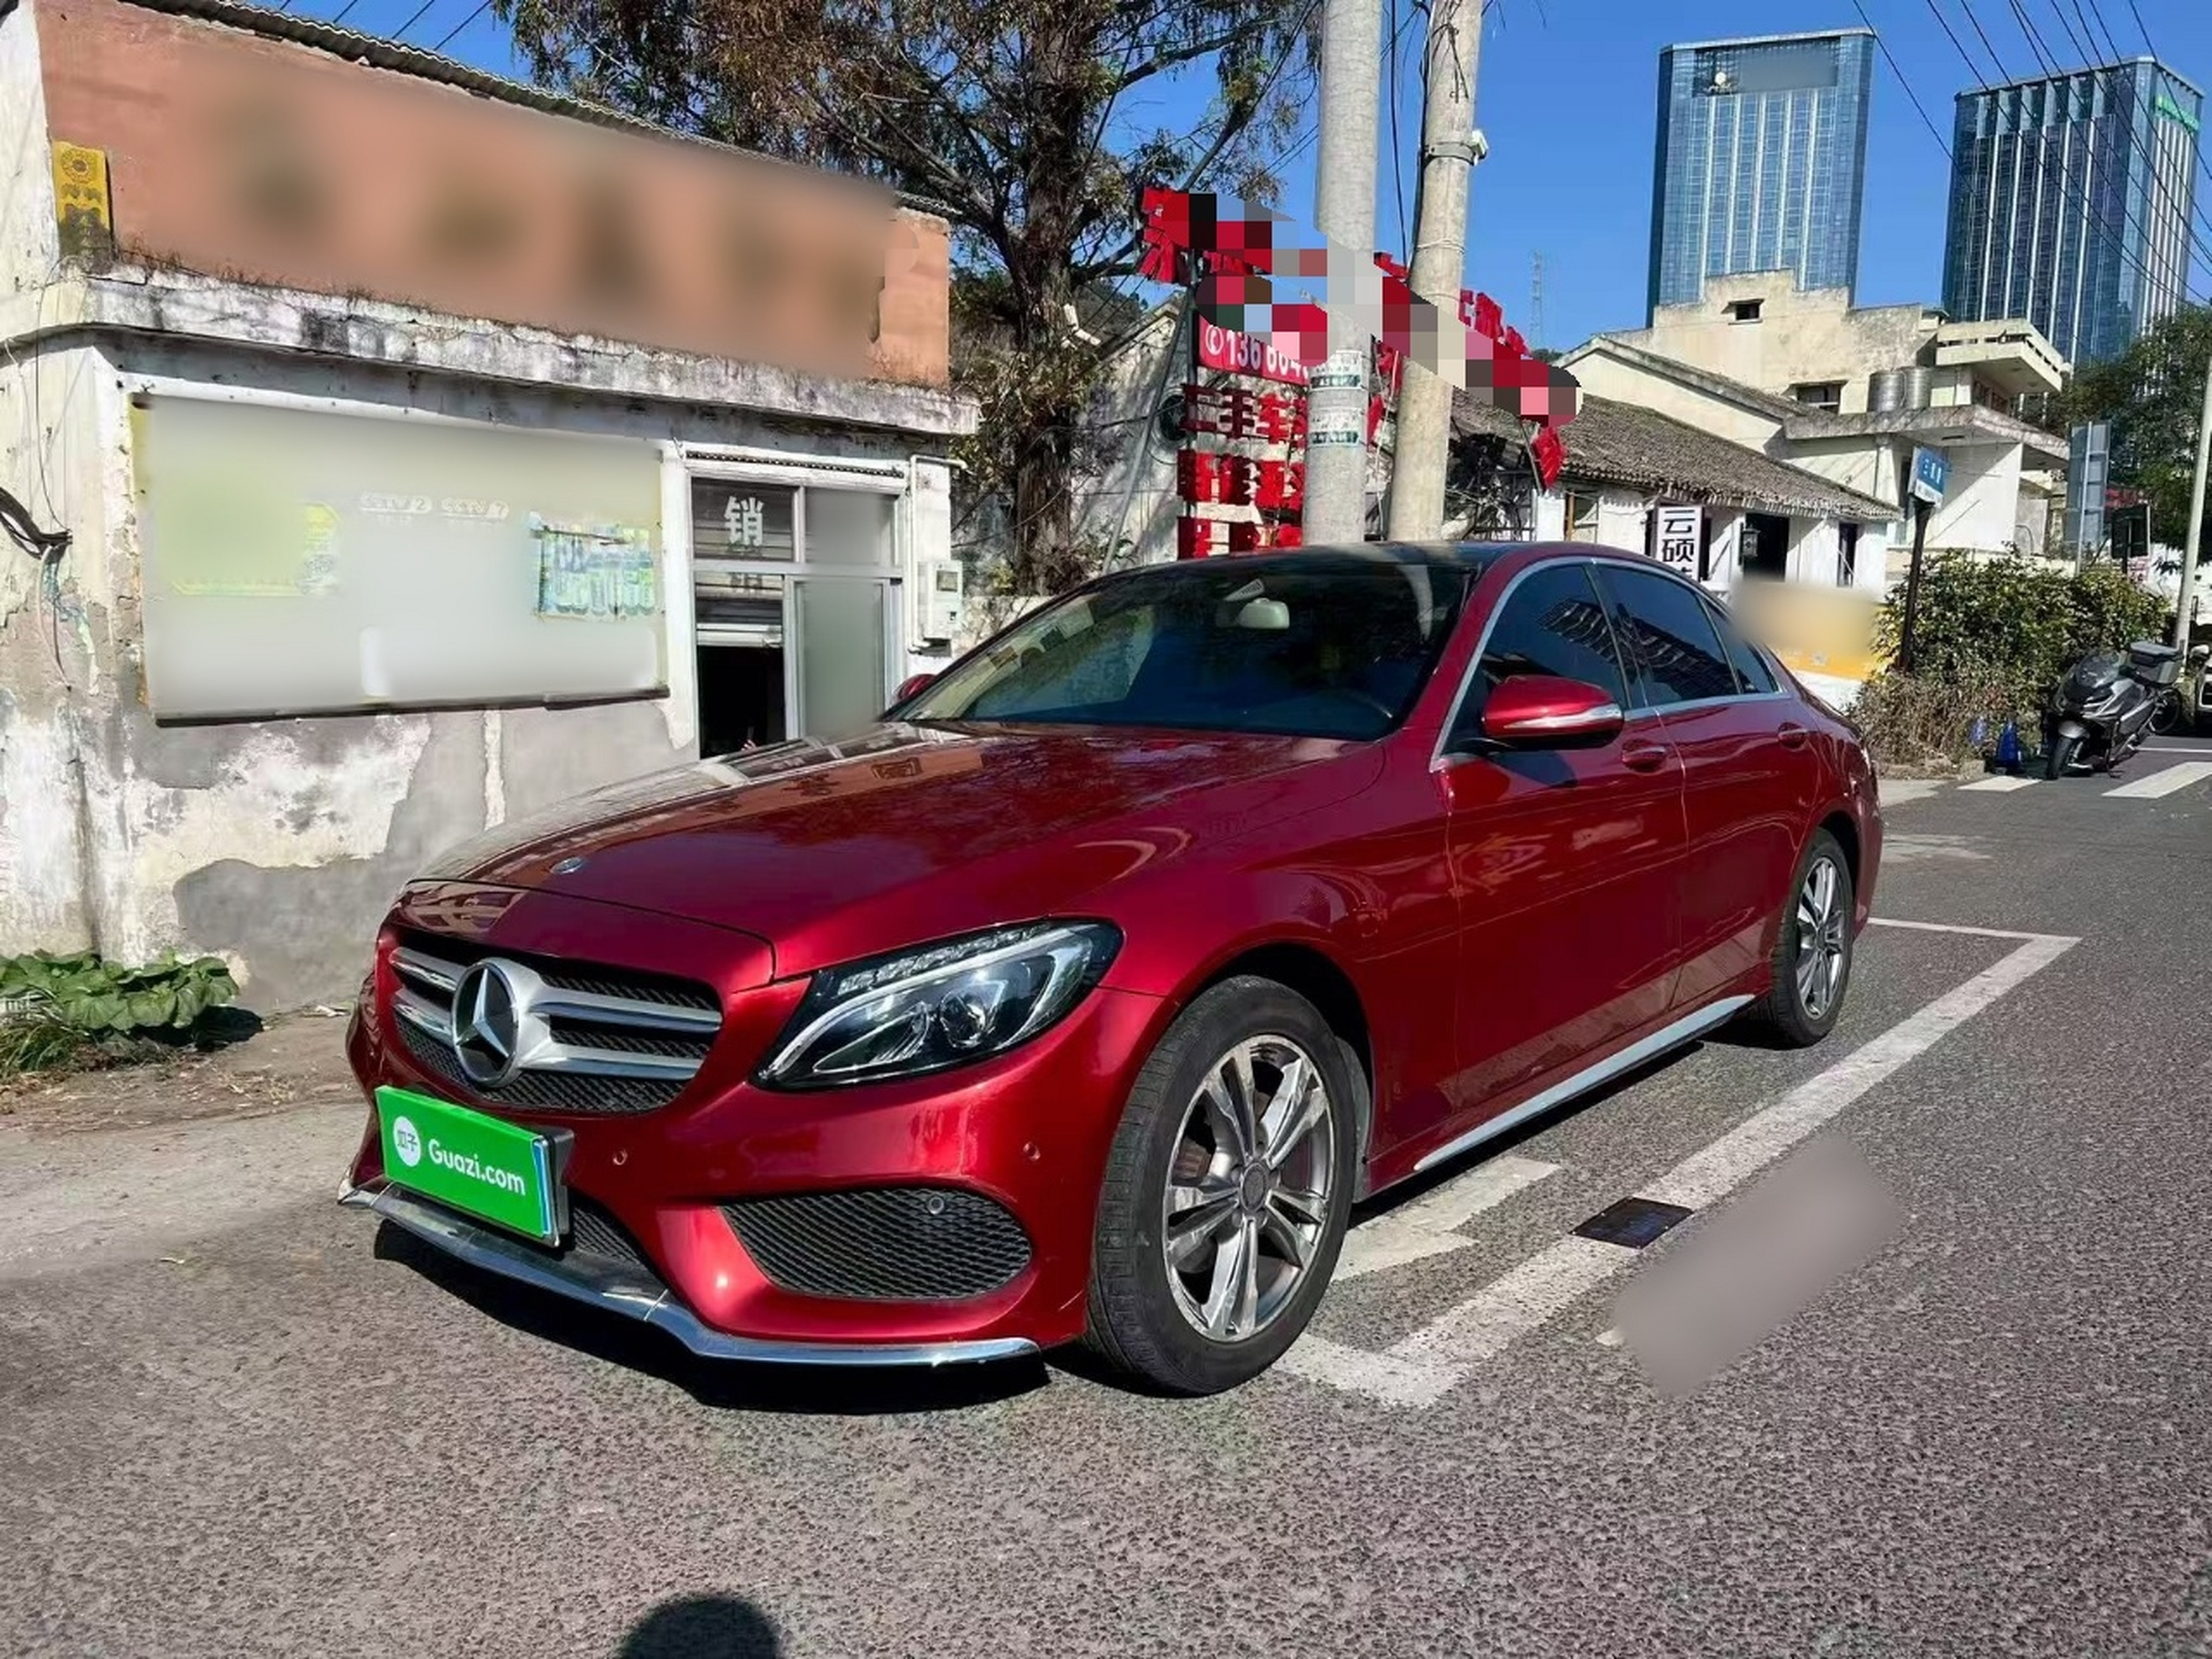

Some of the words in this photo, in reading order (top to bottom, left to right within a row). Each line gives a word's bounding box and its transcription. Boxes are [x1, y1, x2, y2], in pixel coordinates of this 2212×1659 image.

[724, 495, 764, 546] 销
[1661, 509, 1695, 579] 云硕
[428, 1138, 526, 1196] Guazi.com
